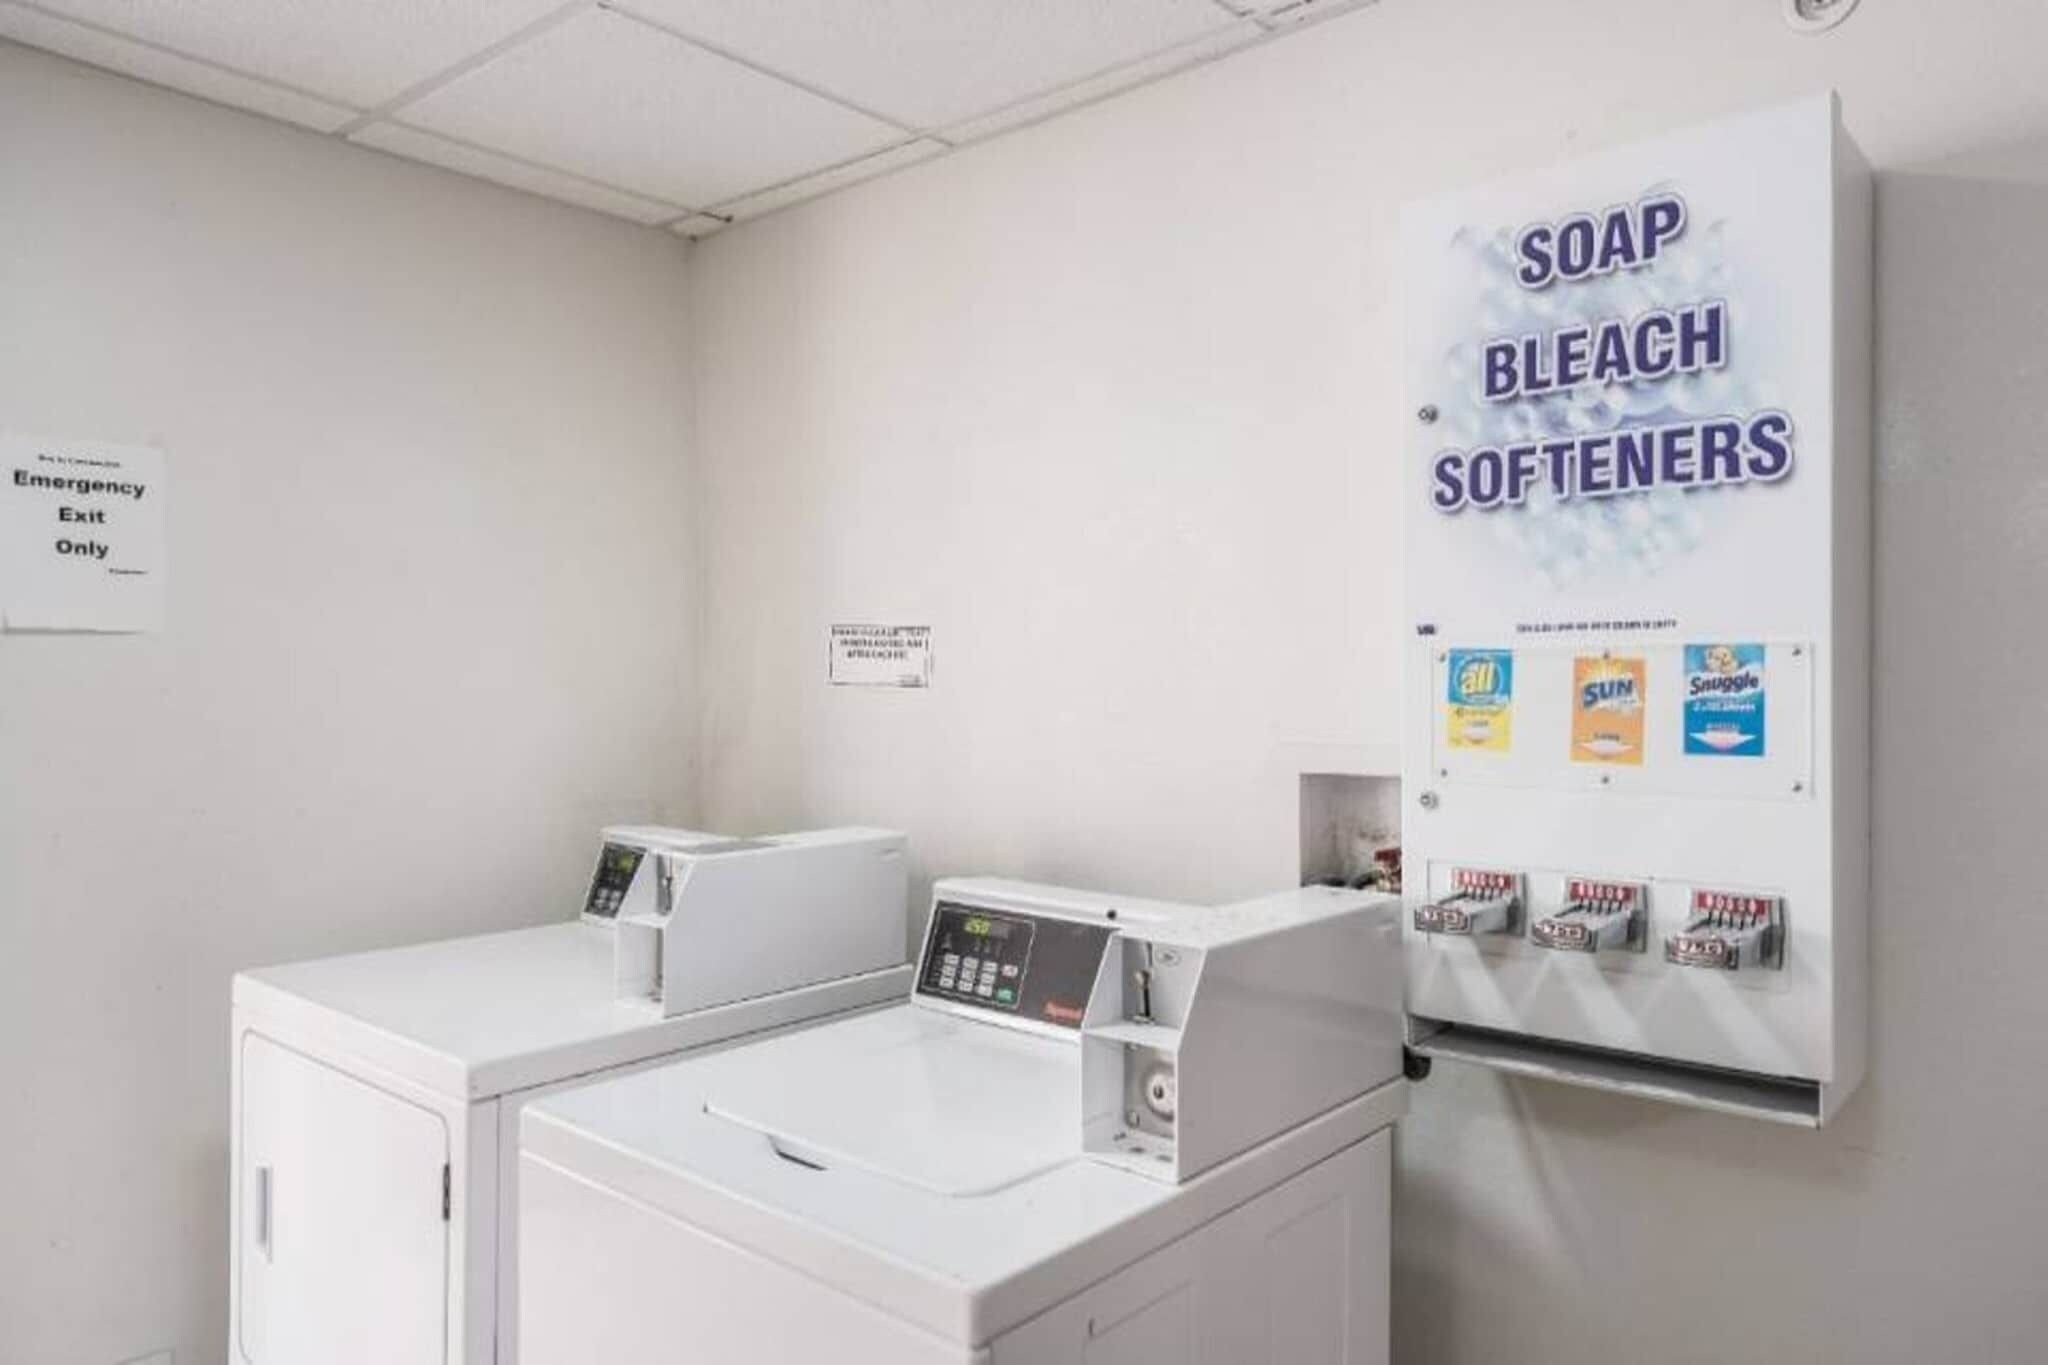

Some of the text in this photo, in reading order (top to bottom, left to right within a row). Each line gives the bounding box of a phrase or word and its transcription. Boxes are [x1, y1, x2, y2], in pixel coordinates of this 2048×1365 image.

[1518, 200, 1683, 285] SOAP
[1485, 304, 1723, 398] BLEACH
[1434, 416, 1789, 508] SOFTENERS
[14, 469, 145, 499] Emergency
[59, 507, 106, 524] Exit
[56, 539, 109, 559] Only
[1461, 662, 1496, 695] all
[1583, 679, 1633, 708] SUN
[1690, 671, 1759, 695] Snuggle
